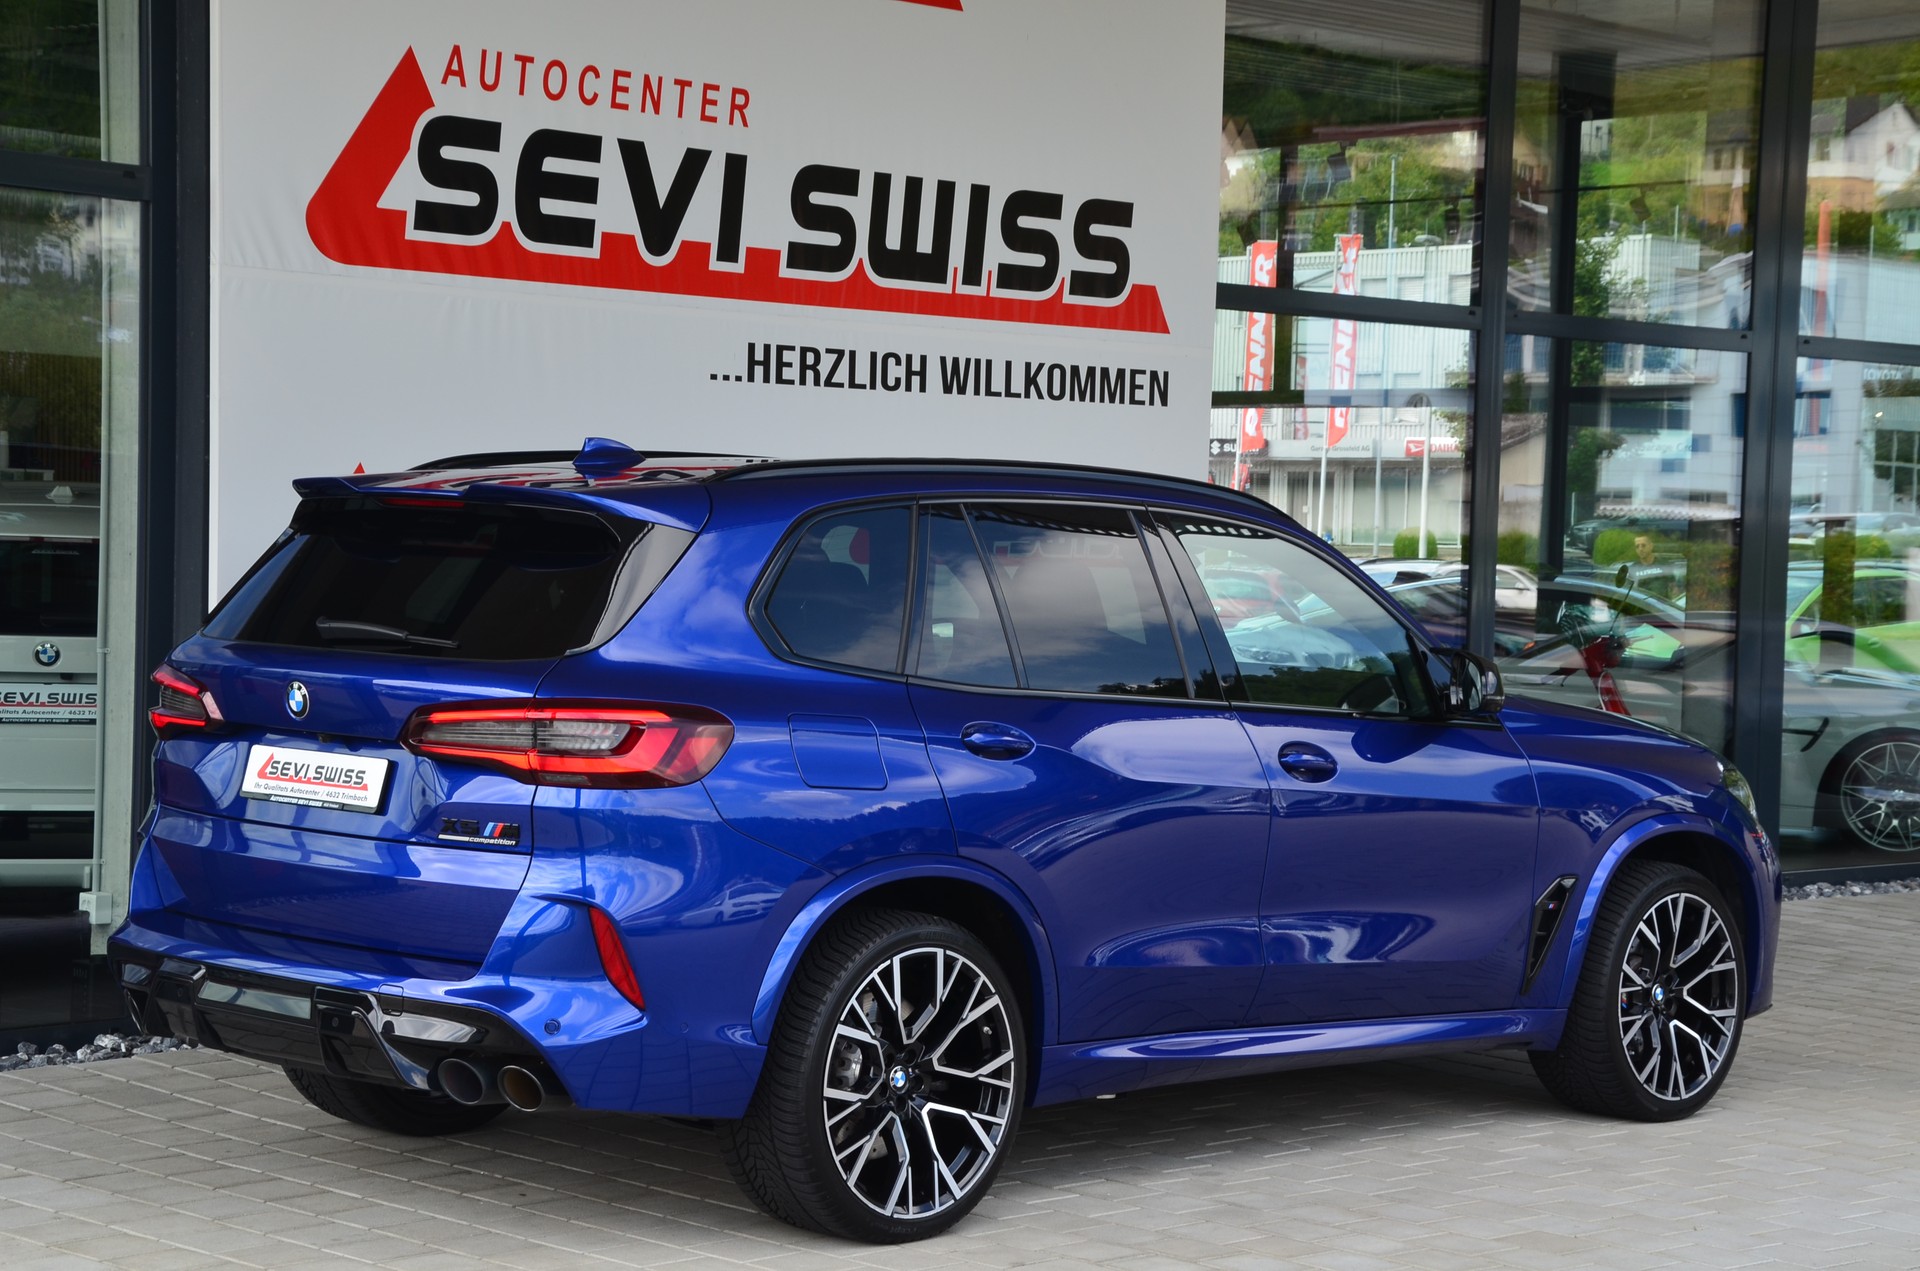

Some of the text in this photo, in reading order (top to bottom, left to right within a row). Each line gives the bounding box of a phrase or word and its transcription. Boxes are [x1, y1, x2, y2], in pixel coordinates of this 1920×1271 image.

[441, 44, 751, 128] AUTOCENTER
[413, 115, 1134, 299] SEVI SWISS
[710, 342, 1170, 407] ...HERZLICH WILLKOMMEN
[0, 692, 40, 704] EVI
[268, 760, 366, 786] SEVI SWISS
[289, 786, 320, 797] Autocenter
[326, 789, 341, 799] 4632
[341, 792, 368, 802] Trimbach
[441, 817, 479, 835] X5
